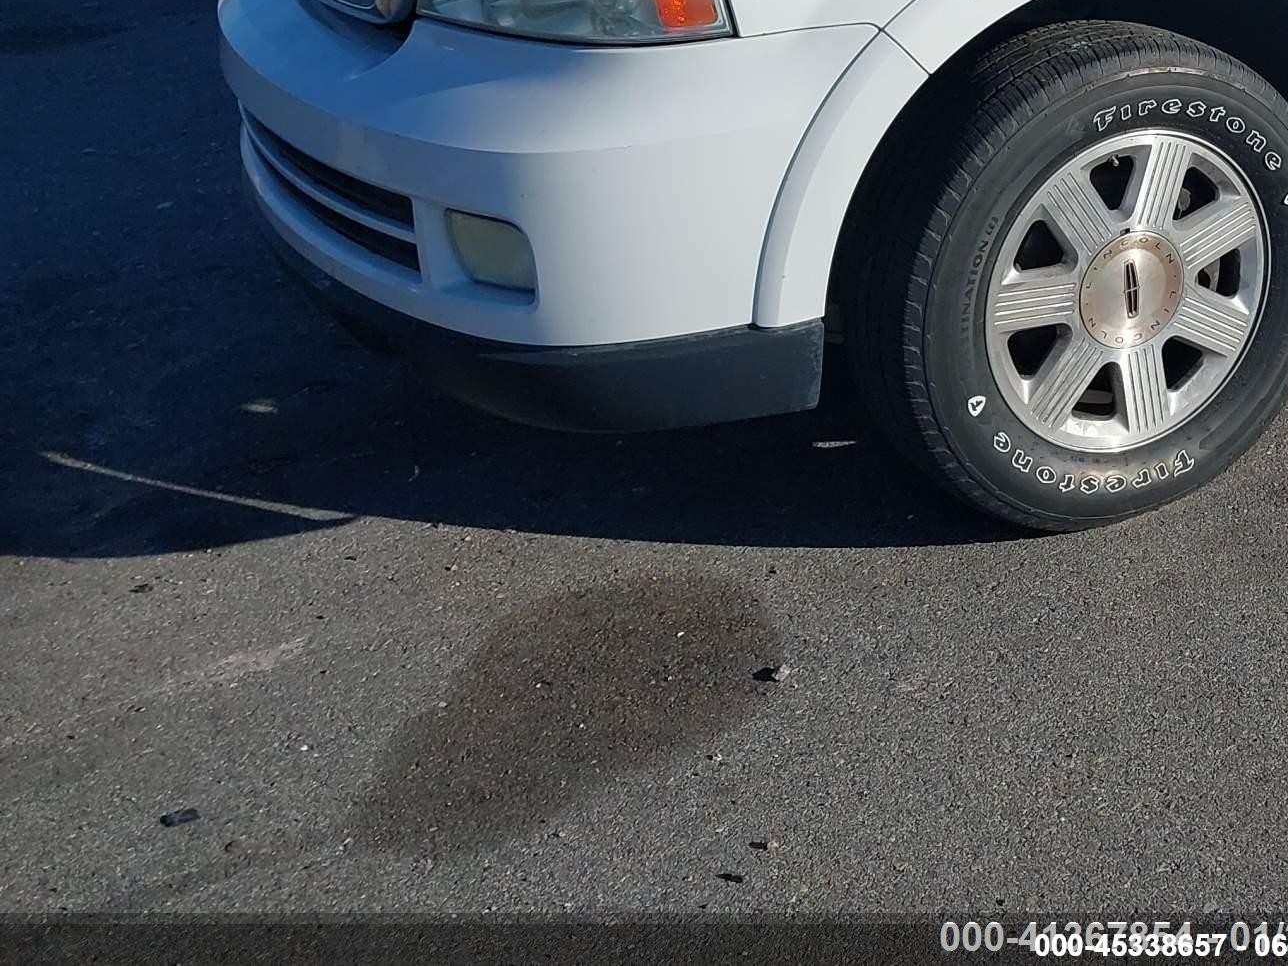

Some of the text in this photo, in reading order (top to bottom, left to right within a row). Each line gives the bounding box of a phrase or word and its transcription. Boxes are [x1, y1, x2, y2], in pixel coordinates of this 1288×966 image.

[1093, 98, 1282, 171] Firestone
[1085, 237, 1175, 290] LINCOLN
[1088, 290, 1177, 344] LINCOLN
[993, 431, 1195, 494] Firestone
